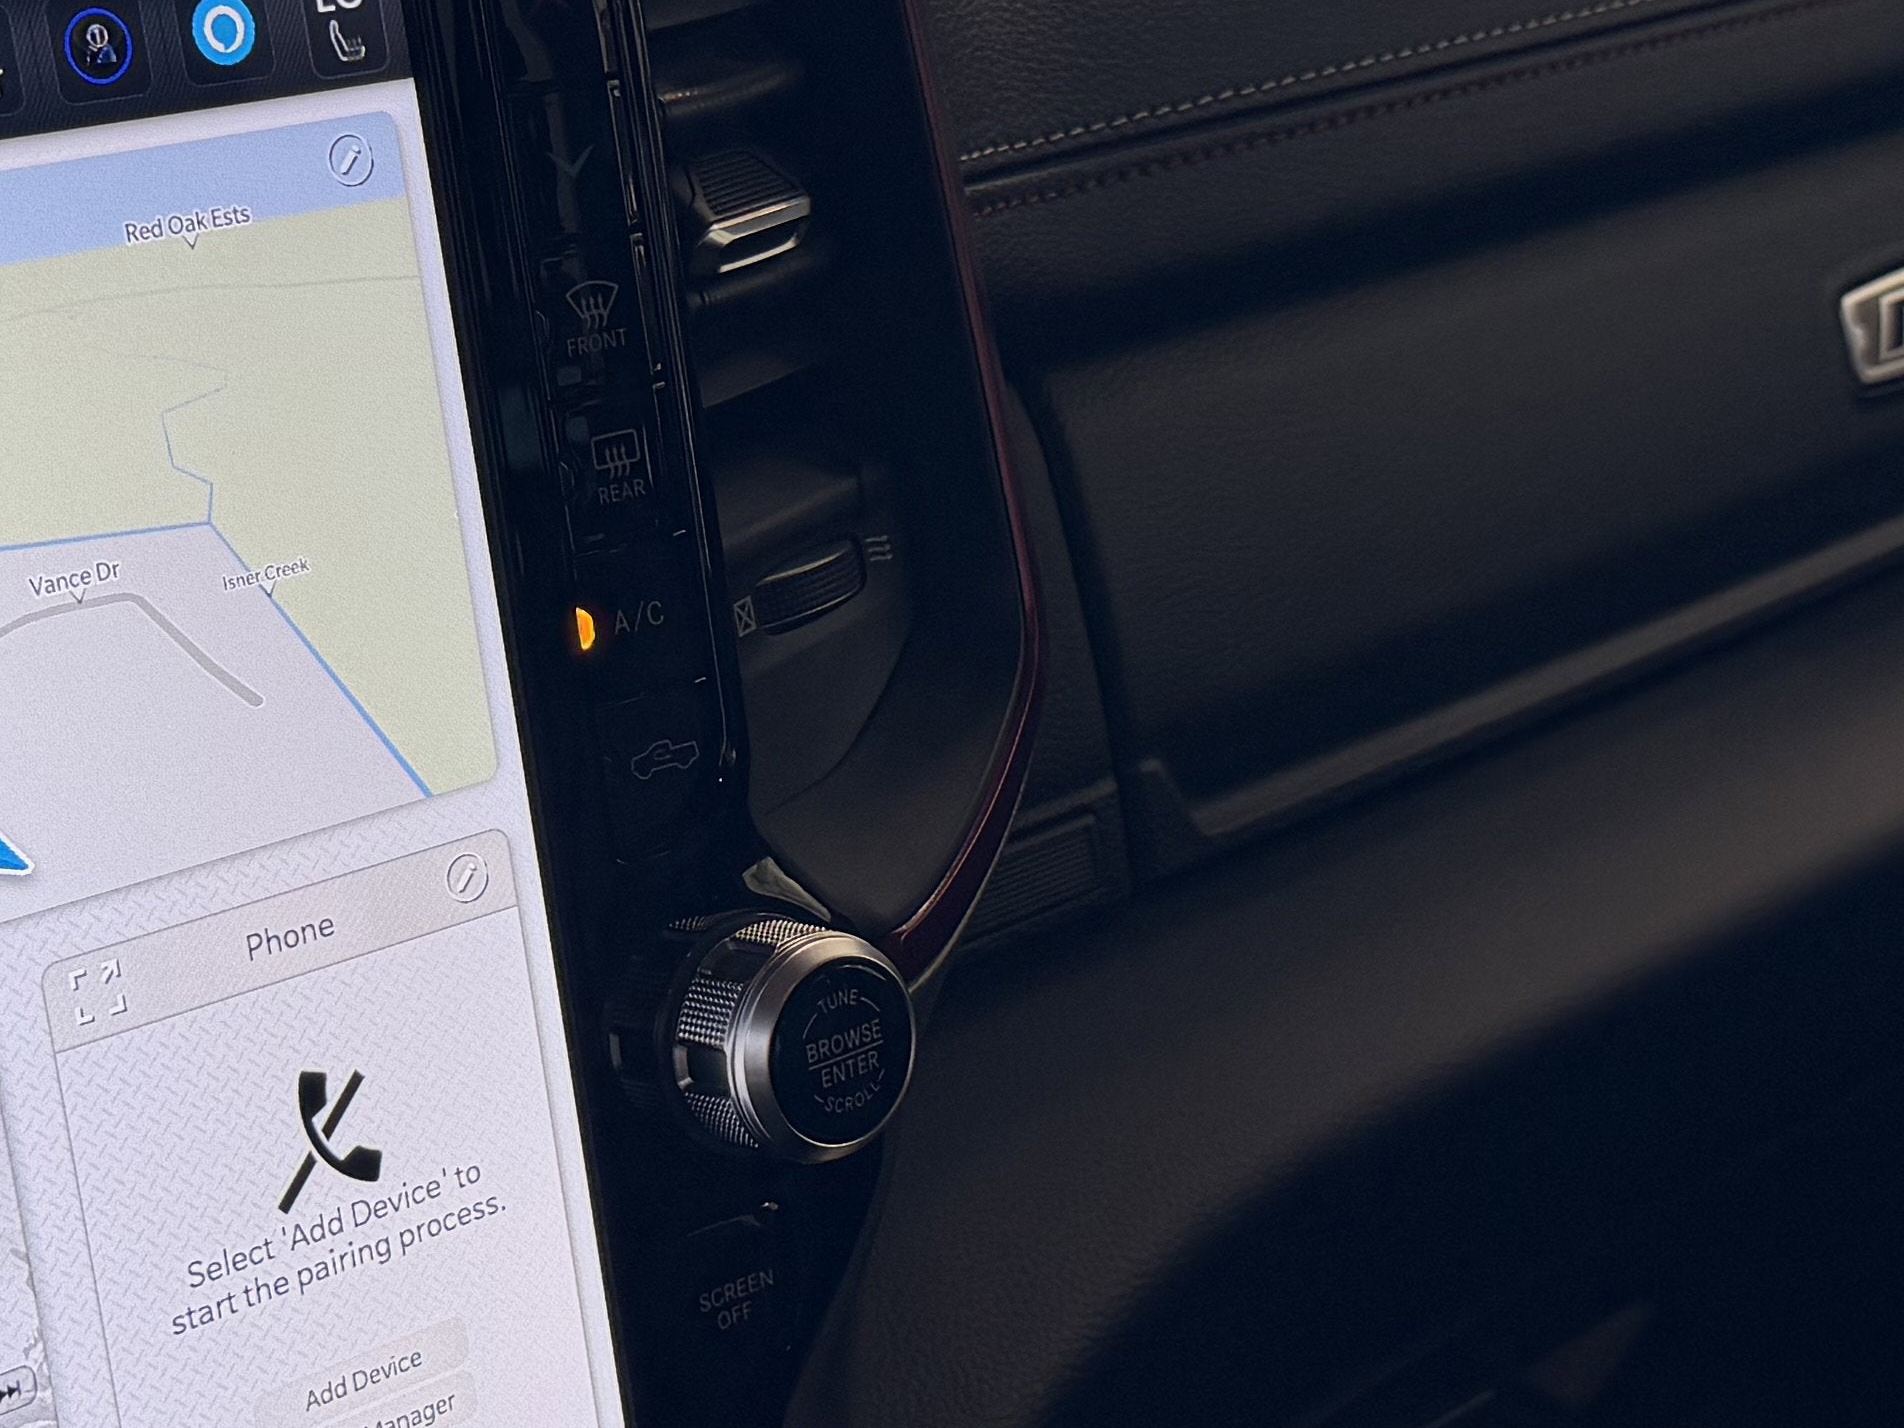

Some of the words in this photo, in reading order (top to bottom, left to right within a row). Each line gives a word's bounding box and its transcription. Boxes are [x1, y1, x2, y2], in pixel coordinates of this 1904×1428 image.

[124, 217, 164, 244] Red
[168, 209, 208, 238] Oak
[210, 204, 251, 230] Ests
[566, 327, 627, 358] FRONT
[597, 478, 646, 505] REAR
[28, 567, 92, 598] Vance
[95, 560, 121, 584] Dr
[222, 568, 262, 592] Isner
[264, 557, 310, 582] Creek
[613, 599, 665, 636] A/C
[246, 916, 336, 961] Phone
[818, 988, 859, 1015] TUNE
[805, 1017, 883, 1062] BROWSE
[820, 1052, 881, 1089] ENTER
[823, 1079, 882, 1115] SCROLL
[187, 1237, 276, 1290] Select
[280, 1207, 344, 1252] 'Add
[350, 1166, 448, 1228] Device'
[454, 1162, 482, 1188] to
[171, 1291, 237, 1337] start
[243, 1273, 290, 1306] the
[297, 1235, 393, 1294] pairing
[399, 1195, 508, 1253] process.
[699, 1268, 775, 1314] SCREEN
[717, 1302, 753, 1331] OFF
[304, 1375, 348, 1412] Add
[352, 1347, 424, 1395] Device
